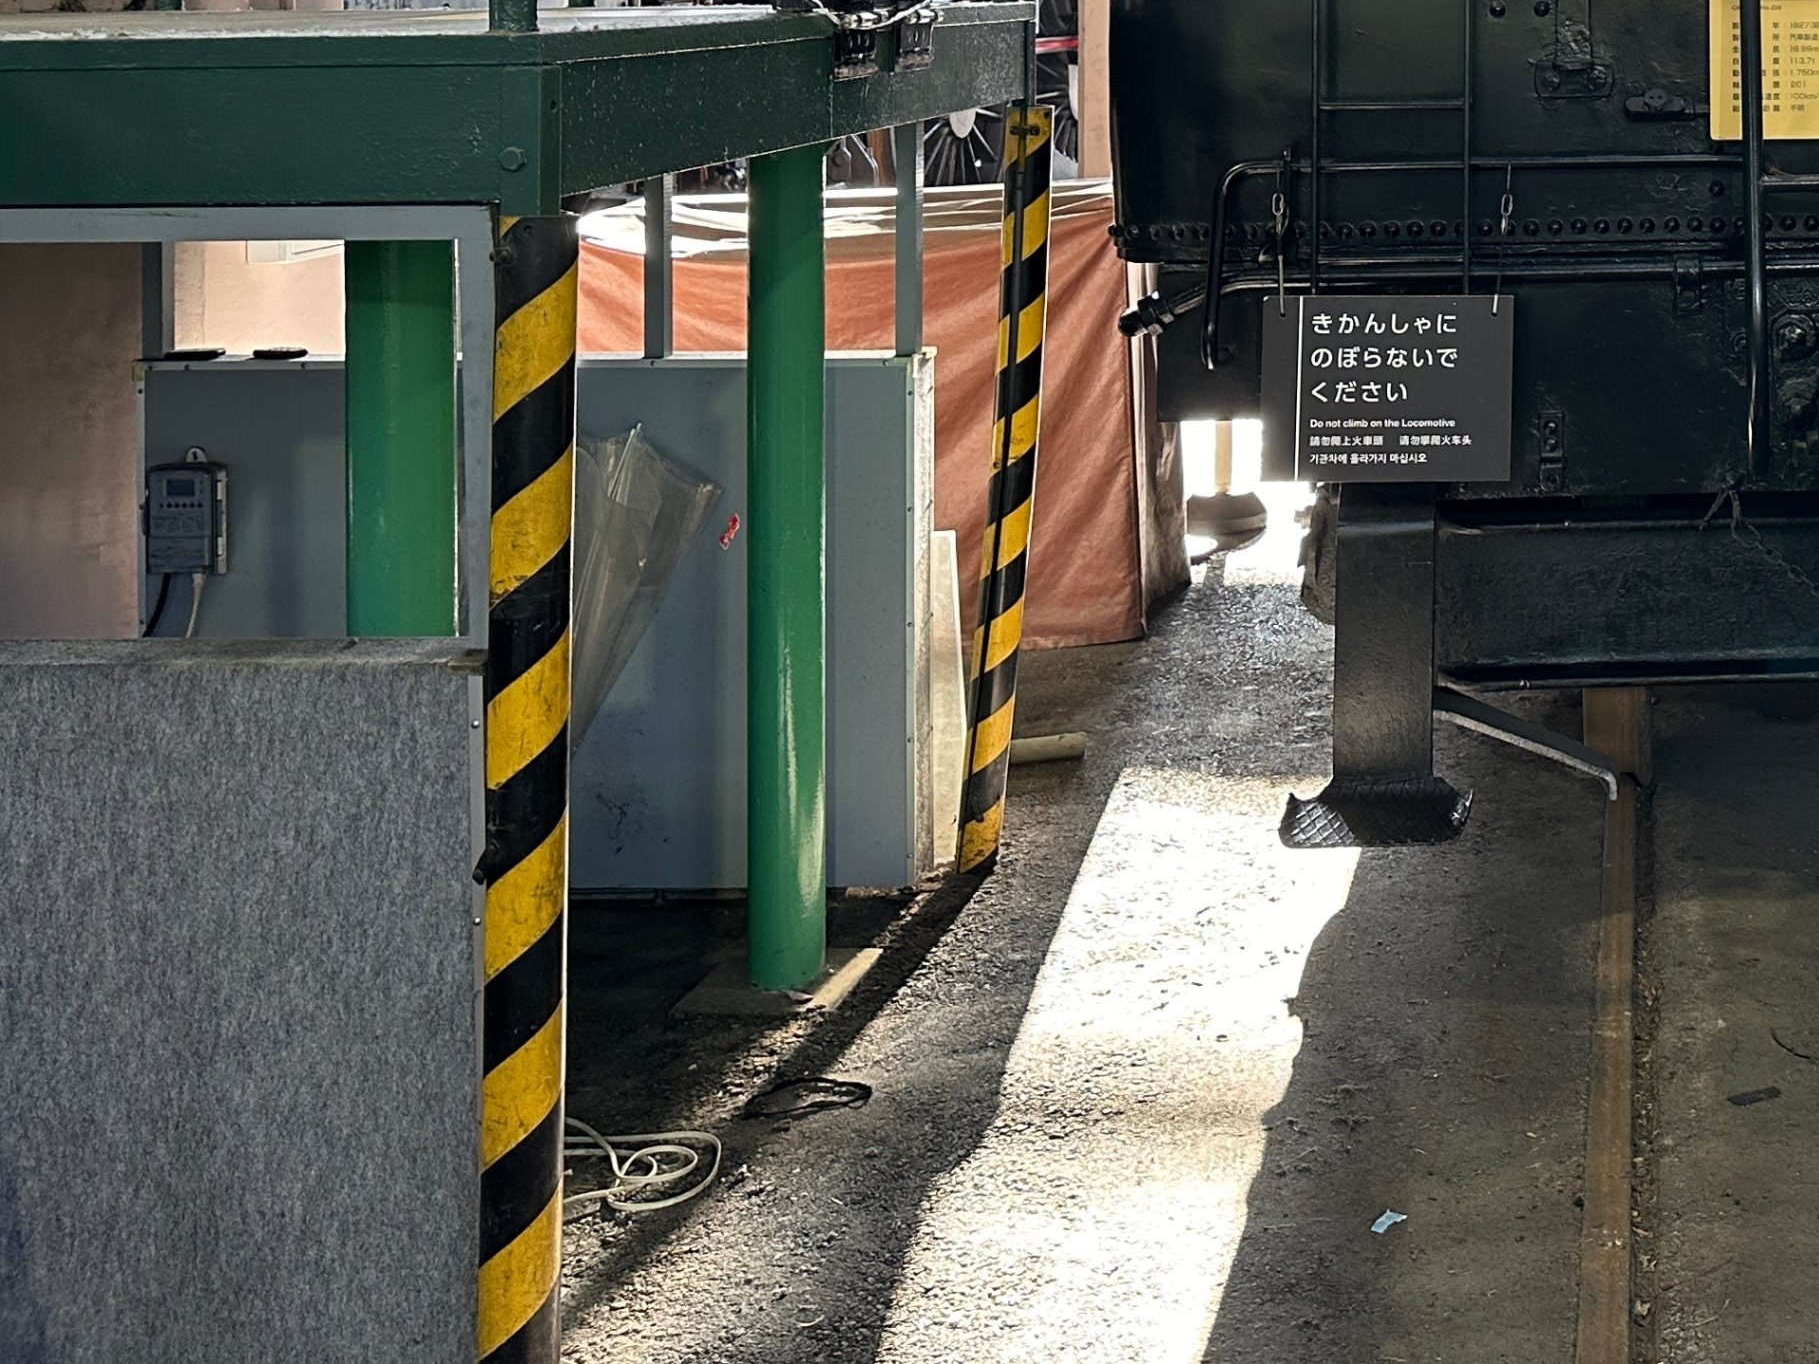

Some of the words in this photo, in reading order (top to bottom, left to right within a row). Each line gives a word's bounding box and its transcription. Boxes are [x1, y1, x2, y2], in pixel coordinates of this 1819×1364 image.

[1311, 313, 1457, 334] きかんしゃに
[1310, 347, 1458, 368] のぼらないで
[1311, 381, 1408, 403] ください
[1310, 419, 1324, 428] Do
[1325, 419, 1341, 428] not
[1343, 419, 1369, 428] climb
[1370, 420, 1382, 428] on
[1384, 419, 1400, 427] the
[1401, 419, 1456, 427] Locomotive
[1309, 453, 1348, 464] 기관차에
[1350, 453, 1387, 464] 올라가지
[1389, 453, 1427, 464] 마십시오
